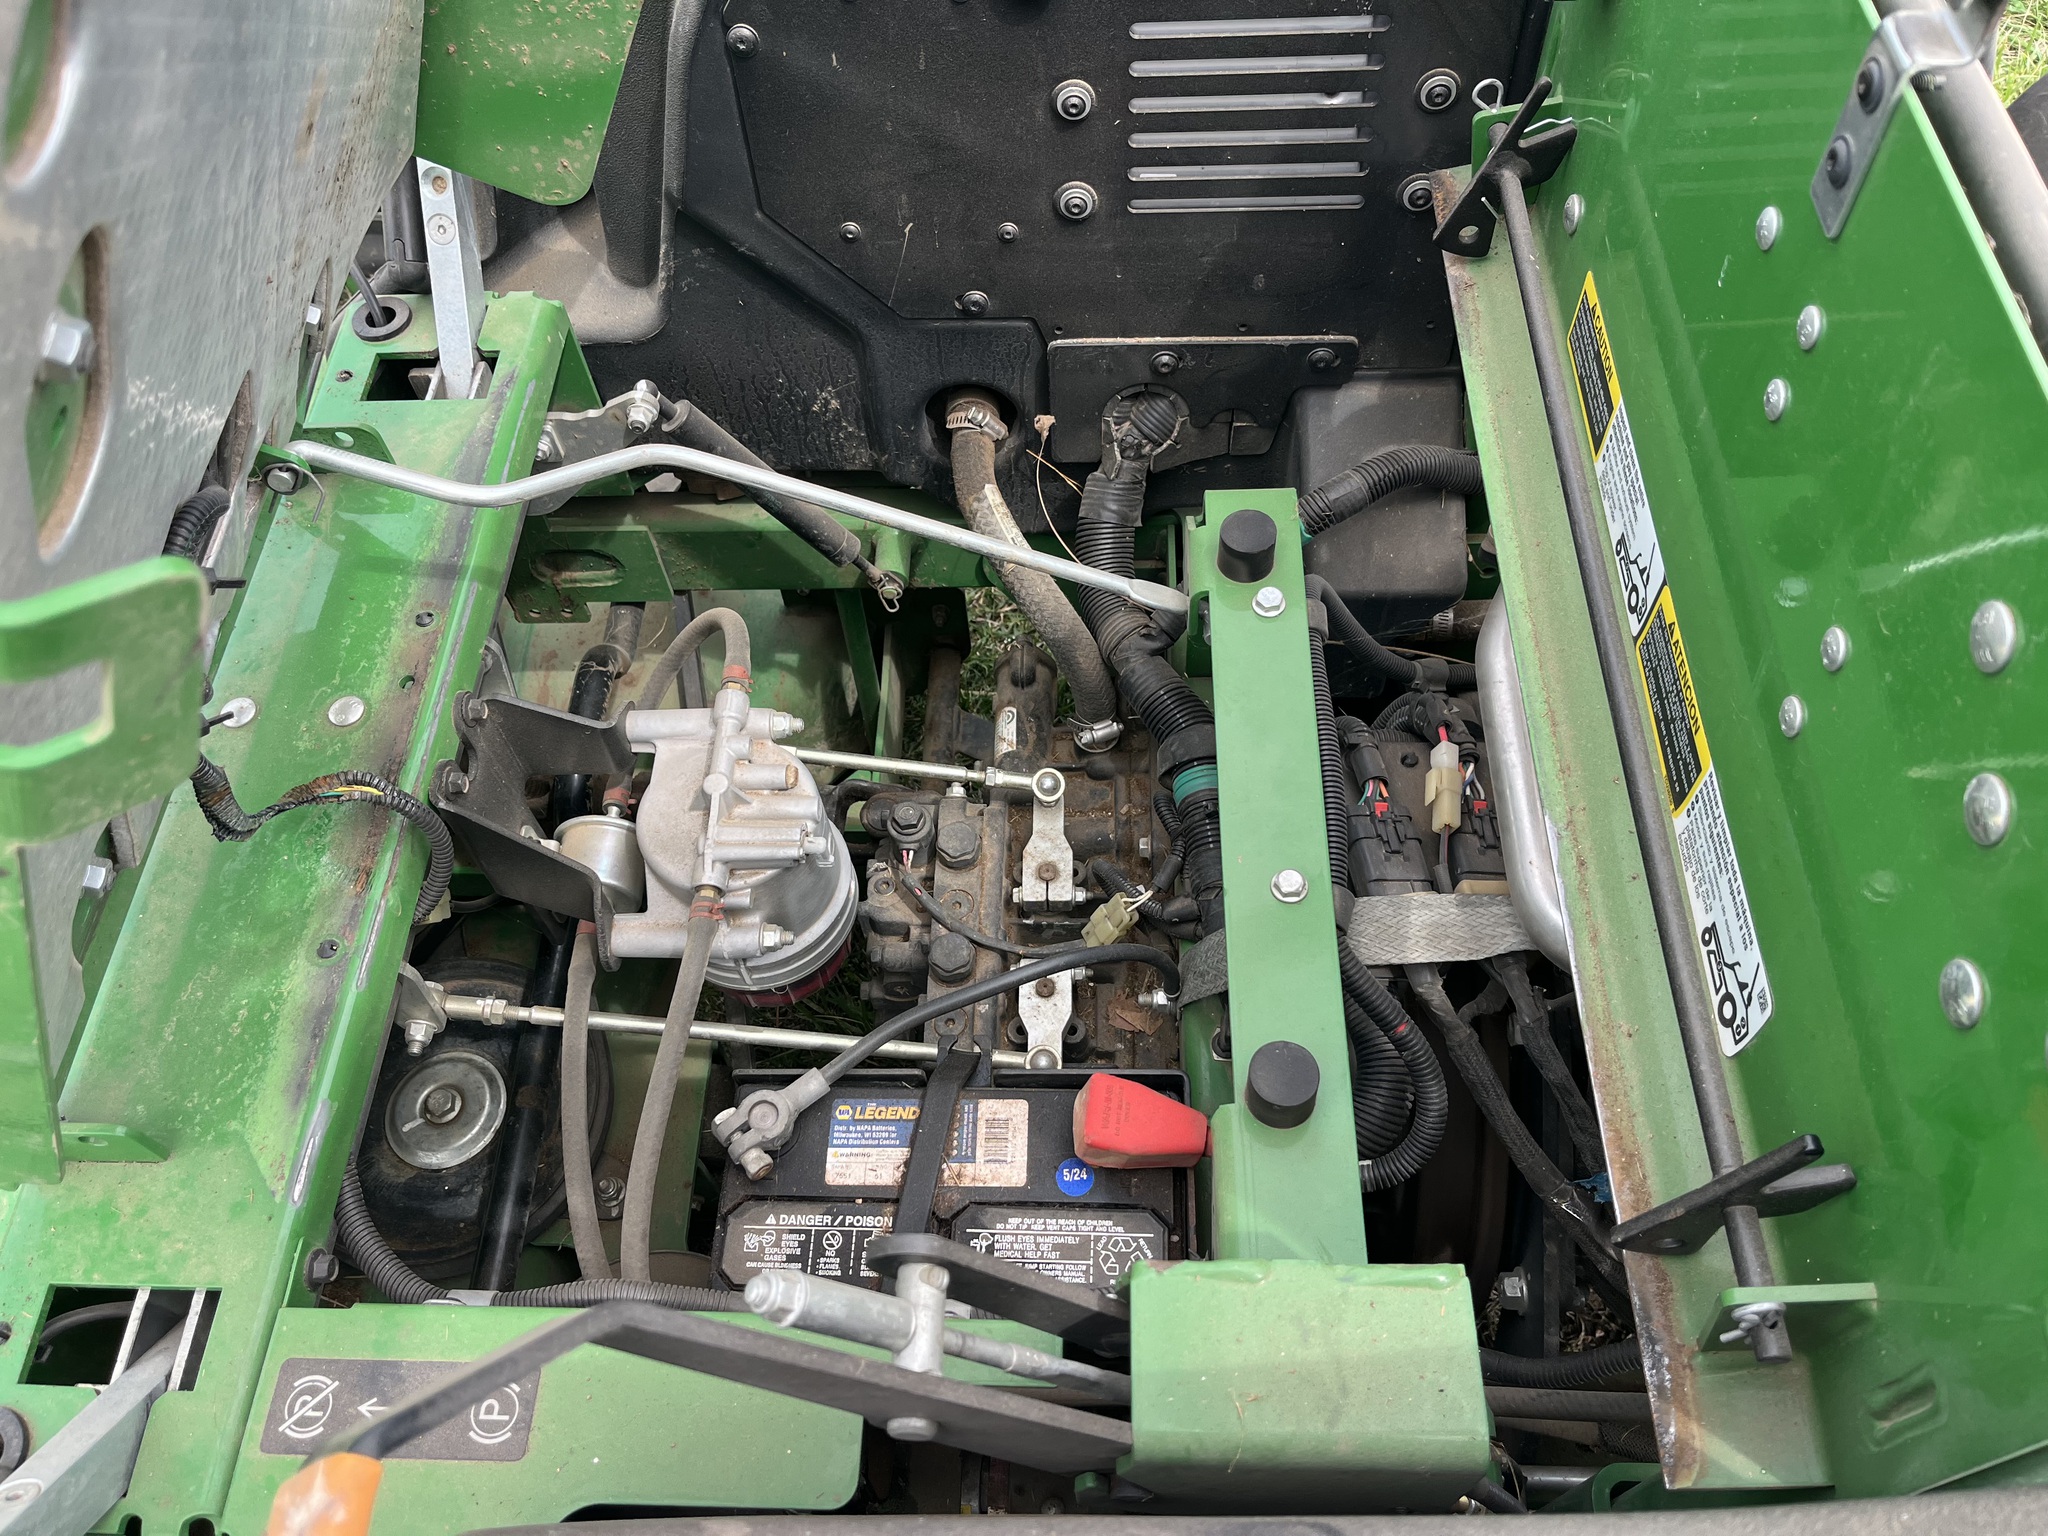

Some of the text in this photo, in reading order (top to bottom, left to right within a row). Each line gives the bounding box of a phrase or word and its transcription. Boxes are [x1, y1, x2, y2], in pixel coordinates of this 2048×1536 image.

[1594, 313, 1613, 382] CAUTION
[1672, 636, 1700, 736] ATENCION
[1698, 786, 1724, 879] puntos siguientes:
[1707, 771, 1719, 810] Revisar
[1715, 812, 1721, 821] y
[1719, 819, 1731, 859] limpiar
[1729, 859, 1737, 884] toda
[1735, 883, 1741, 896] la
[1677, 832, 1689, 872] escudos
[1703, 779, 1748, 952] prestando atención especial a los
[854, 1106, 920, 1119] LEGEND
[1063, 1168, 1087, 1181] 5/24
[779, 1215, 831, 1226] DANGER
[845, 1216, 893, 1227] POISON
[1013, 1243, 1038, 1251] WATER.
[1018, 1235, 1035, 1243] EYES
[1036, 1236, 1079, 1244] IMMEDIATELY
[1096, 1236, 1107, 1251] LEAD
[1138, 1238, 1153, 1259] RETURN
